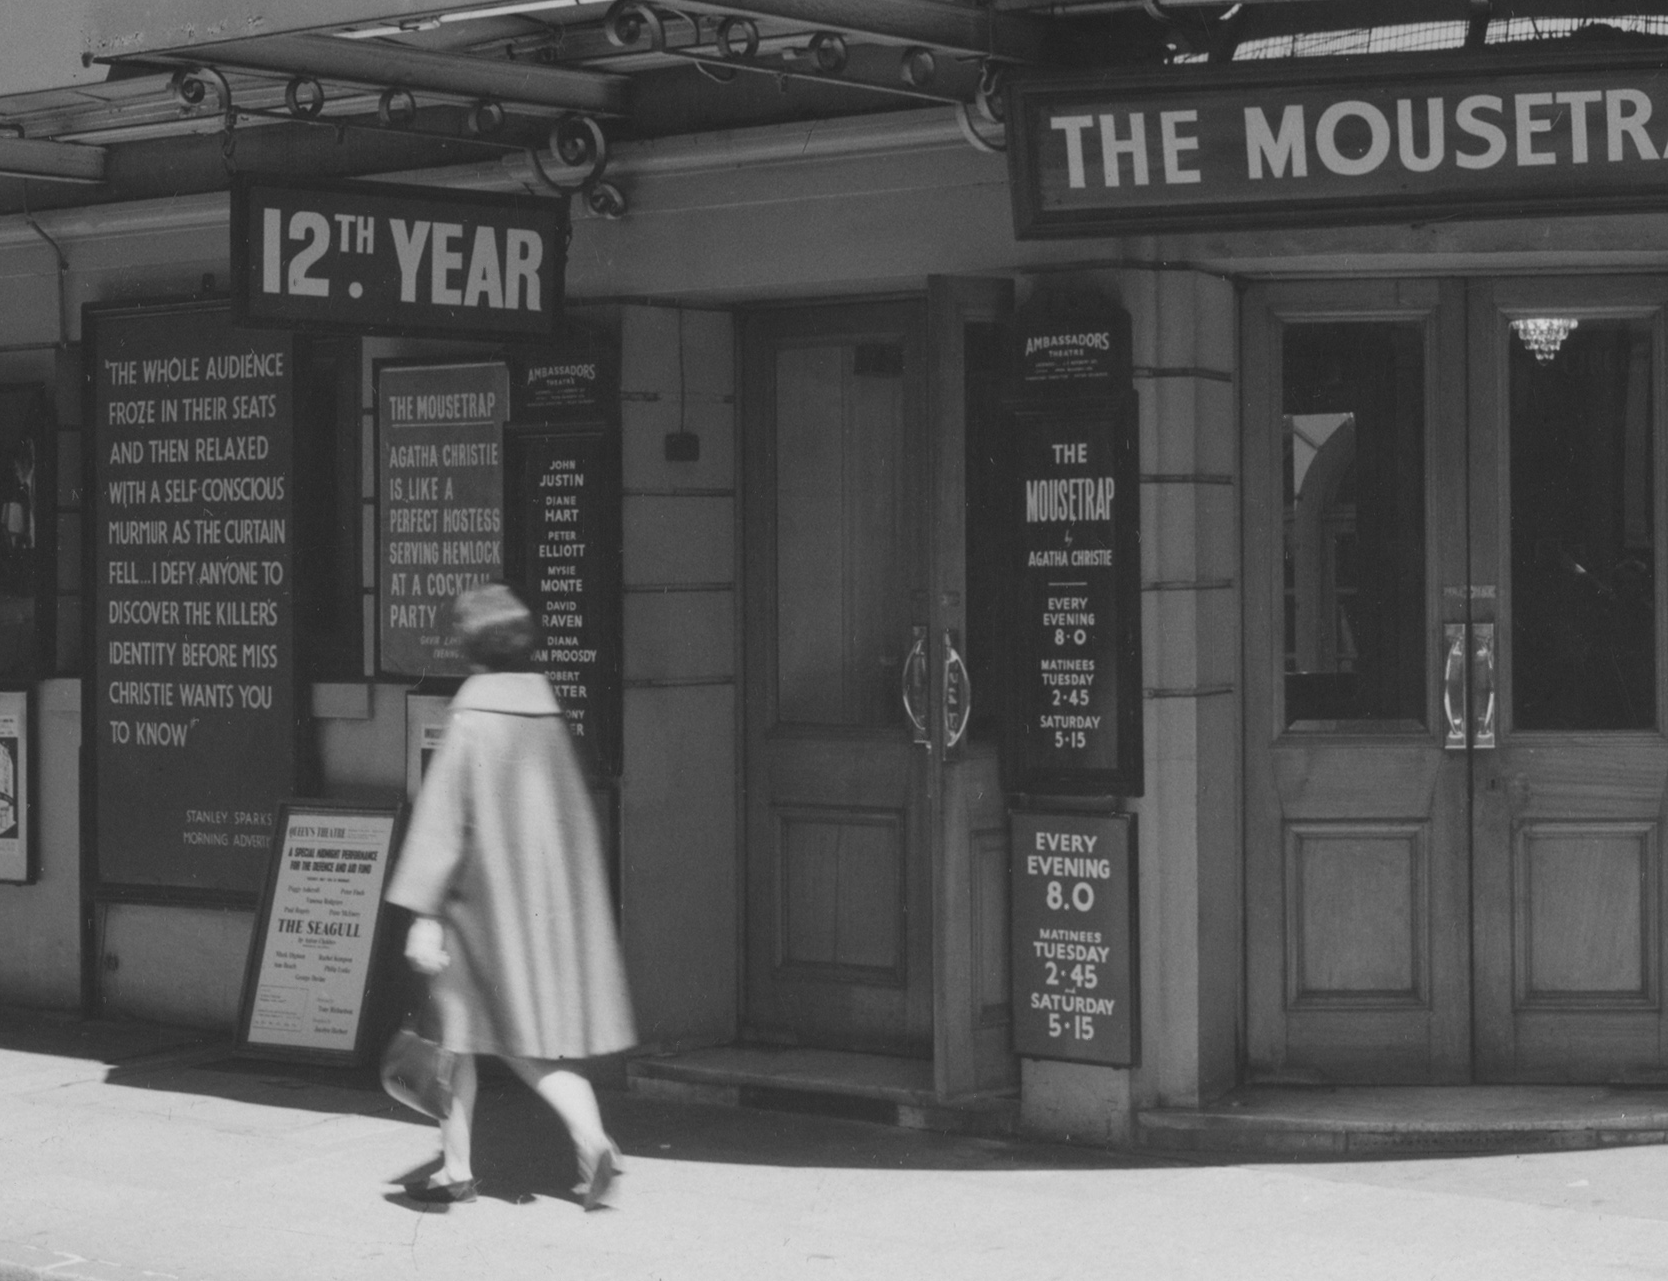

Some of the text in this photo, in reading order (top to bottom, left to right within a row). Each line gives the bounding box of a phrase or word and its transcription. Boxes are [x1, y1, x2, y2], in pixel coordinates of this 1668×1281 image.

[1050, 109, 1202, 190] THE
[389, 218, 543, 311] YEAR
[1025, 332, 1109, 356] AMBASSADORS
[143, 353, 283, 383] WHOLE AUDIENCE
[528, 364, 595, 385] AMBASSADORS
[109, 394, 276, 425] FROZE IN THEIR SEATS
[389, 392, 495, 421] THE MOUSETRAP
[110, 435, 269, 465] AND THEN RELAXED
[442, 443, 498, 467] CHRISTIE
[1052, 443, 1088, 464] THE
[549, 460, 576, 470] JOHN
[390, 477, 454, 501] IS LIKE A
[540, 474, 584, 487] JUSTIN
[109, 481, 146, 504] WITH
[150, 480, 161, 503] A
[546, 496, 576, 506] DIANE
[1026, 477, 1114, 523] MOUSETRAP
[390, 508, 501, 533] PERFECT HOSTESS
[545, 509, 579, 522] HART
[109, 519, 285, 545] MURMUR AS THE CURTAIN
[548, 531, 576, 541] PETER
[389, 541, 500, 565] SERVING HEMLOCK
[539, 544, 585, 557] ELLIOTT
[1028, 549, 1112, 567] AGATHA CHRISTIE
[161, 561, 283, 585] DEFY ANYONE TO
[548, 566, 576, 576] MYSIE
[391, 573, 407, 595] AT
[541, 579, 582, 592] MONTE
[109, 601, 179, 625] DISCOVER
[184, 602, 211, 625] THE
[547, 601, 576, 611] DAVID
[1048, 597, 1088, 610] EVERY
[542, 614, 582, 627] RAVEN
[1043, 613, 1095, 626] EVENING
[547, 636, 578, 646] DIANA
[109, 642, 278, 669] IDENTITY BEFORE MISS
[1041, 659, 1095, 671] MATINEES
[1041, 673, 1094, 686] TUESDAY
[109, 682, 272, 709] CHRISTIE WANTS YOU
[110, 721, 129, 743] TO
[1040, 715, 1101, 729] SATURDAY
[1035, 831, 1098, 854] EVERY
[1027, 855, 1110, 879] EVENING
[278, 918, 361, 938] THE SEAGULL
[1039, 928, 1102, 944] MATINEES
[1033, 941, 1110, 963] TUESDAY
[1031, 992, 1115, 1015] SATURDAY
